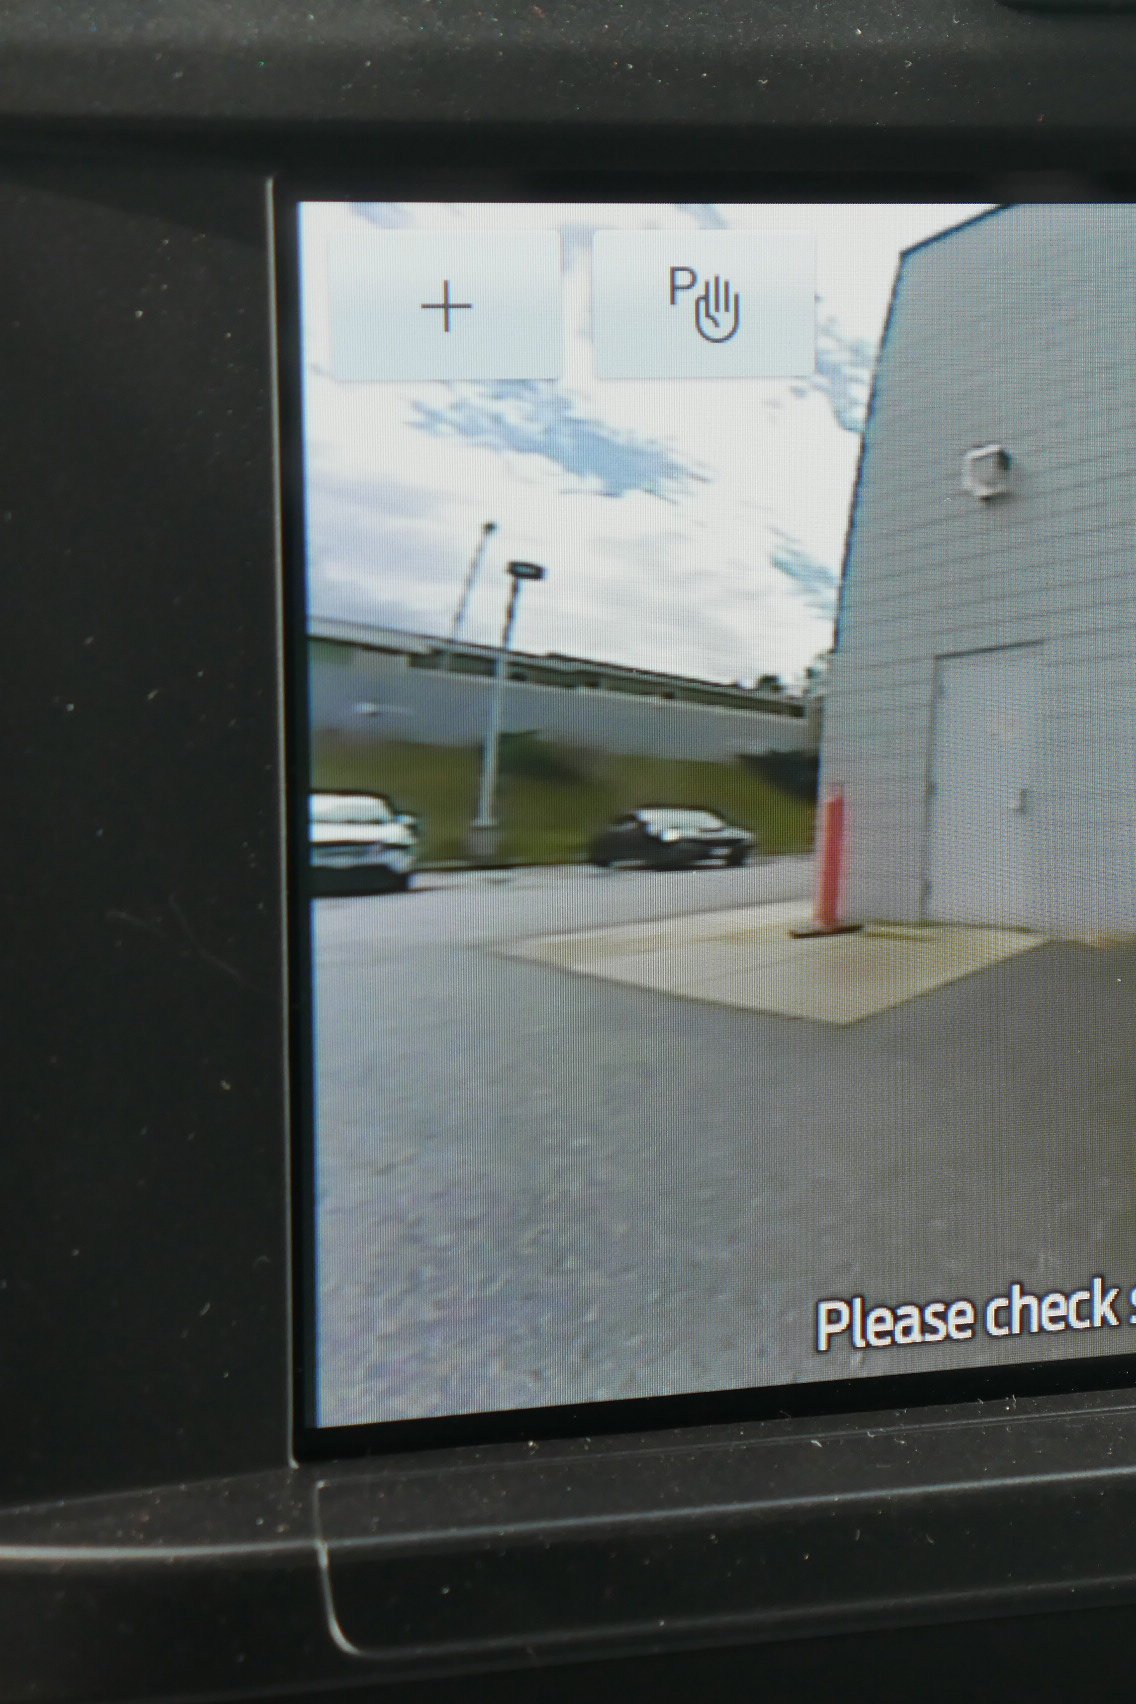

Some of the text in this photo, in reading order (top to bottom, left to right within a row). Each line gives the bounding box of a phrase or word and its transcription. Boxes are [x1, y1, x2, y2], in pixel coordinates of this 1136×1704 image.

[670, 266, 697, 305] P
[816, 1297, 973, 1351] Please
[986, 1276, 1120, 1337] check
